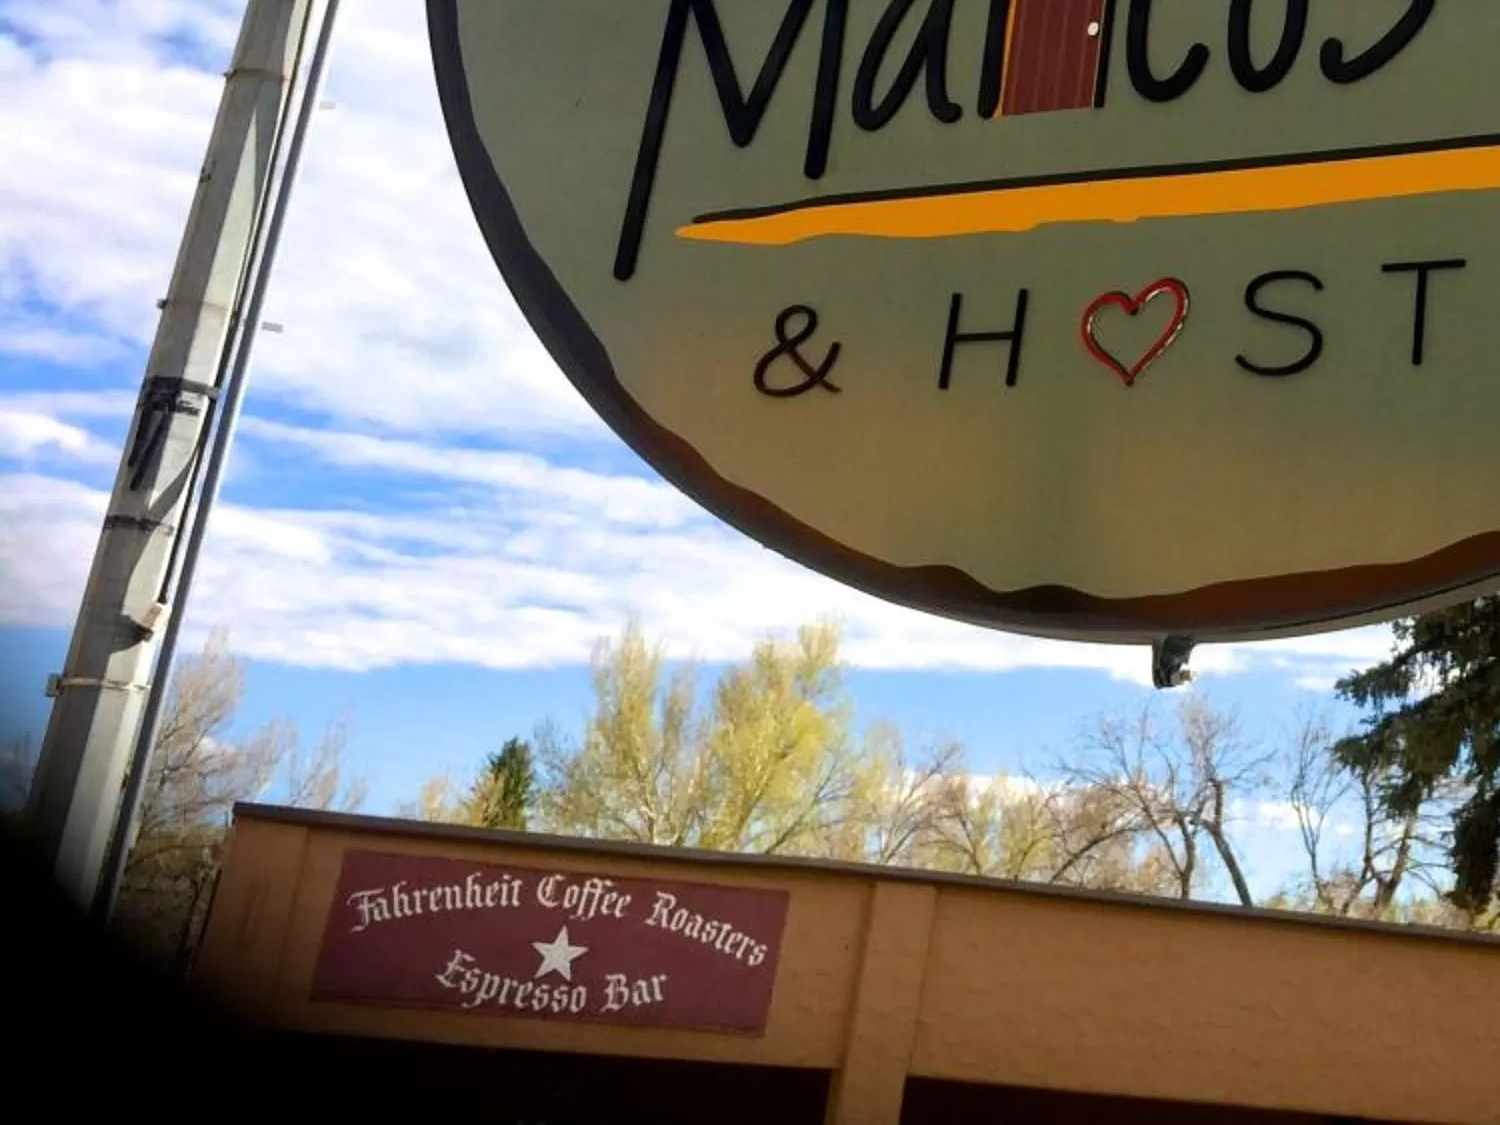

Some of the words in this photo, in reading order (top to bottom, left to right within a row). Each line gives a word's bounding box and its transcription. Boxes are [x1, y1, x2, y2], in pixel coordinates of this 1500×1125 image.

[752, 304, 841, 399] &
[348, 873, 523, 932] Fahrenheit
[536, 874, 632, 921] Coffee
[642, 890, 768, 968] Roasters
[436, 949, 587, 1013] Espresso
[599, 971, 667, 1013] Bar
